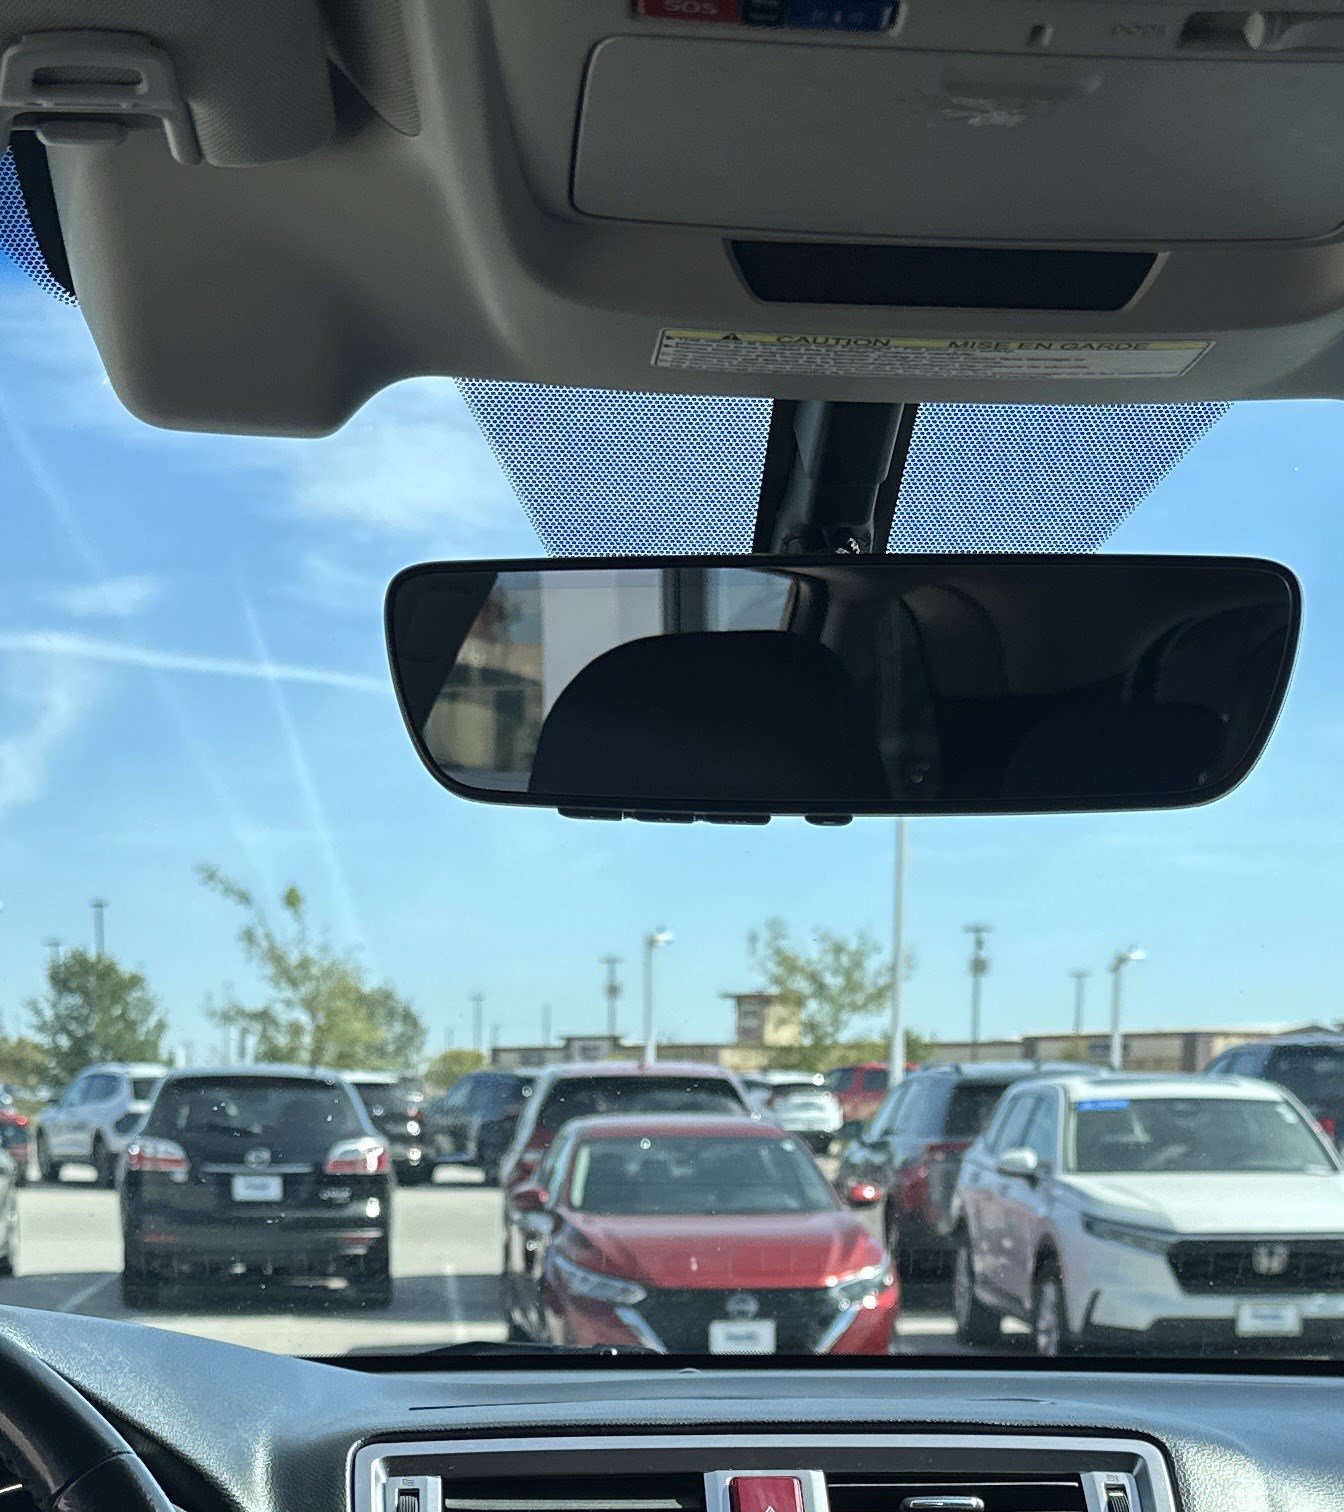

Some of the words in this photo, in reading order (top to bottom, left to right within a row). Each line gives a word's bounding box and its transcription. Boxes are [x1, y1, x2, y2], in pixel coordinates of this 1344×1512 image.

[776, 335, 891, 347] CAUTION
[1017, 341, 1054, 351] EN
[1059, 342, 1150, 351] GARDE
